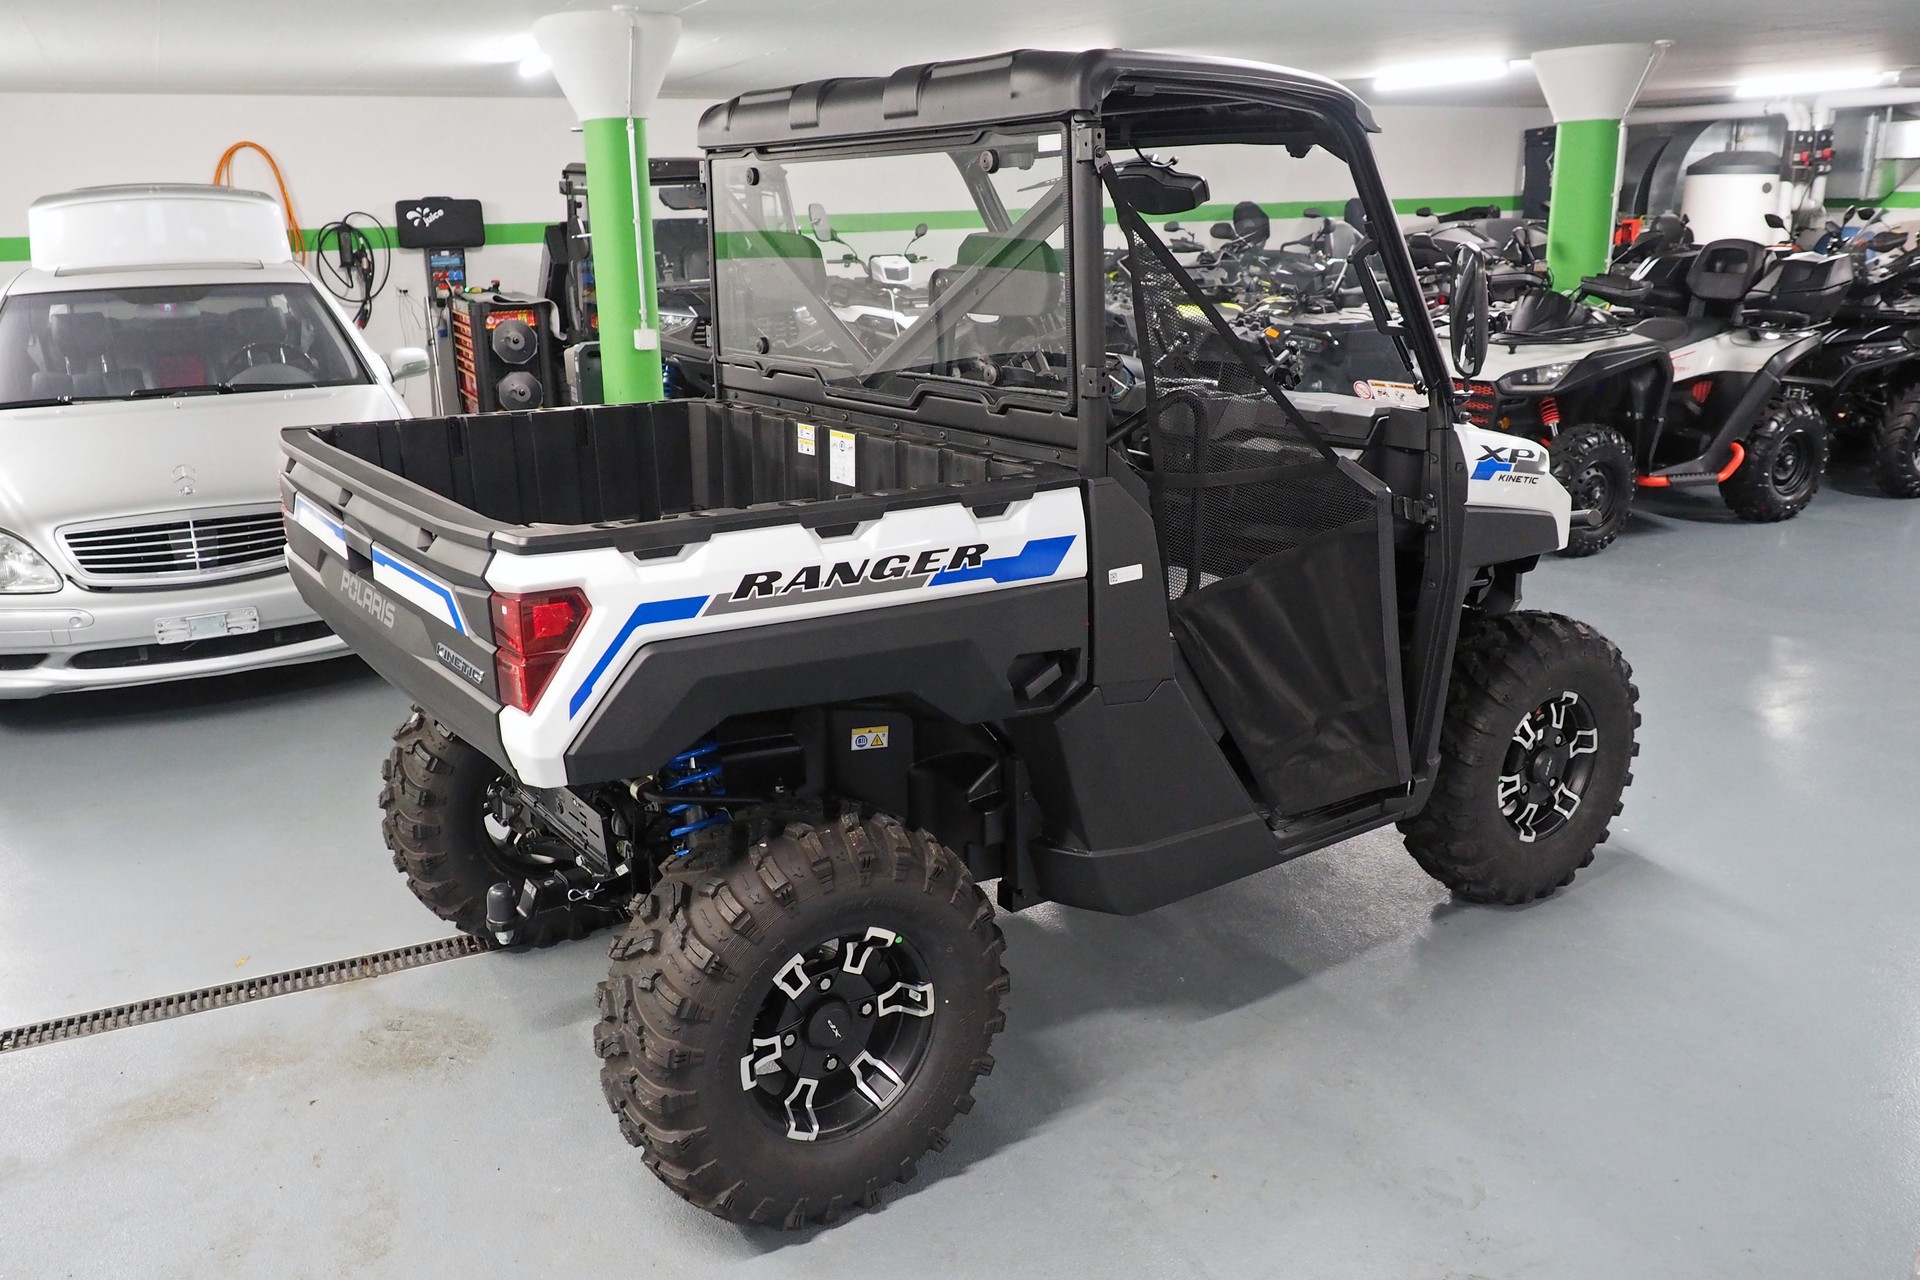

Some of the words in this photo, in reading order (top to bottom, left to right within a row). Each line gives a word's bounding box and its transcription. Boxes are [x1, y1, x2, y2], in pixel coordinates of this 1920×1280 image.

[1475, 444, 1536, 463] XP
[1497, 473, 1539, 485] KINETIC
[731, 543, 990, 601] RANGER
[340, 569, 396, 629] POLARIS
[435, 642, 485, 684] KINETIC
